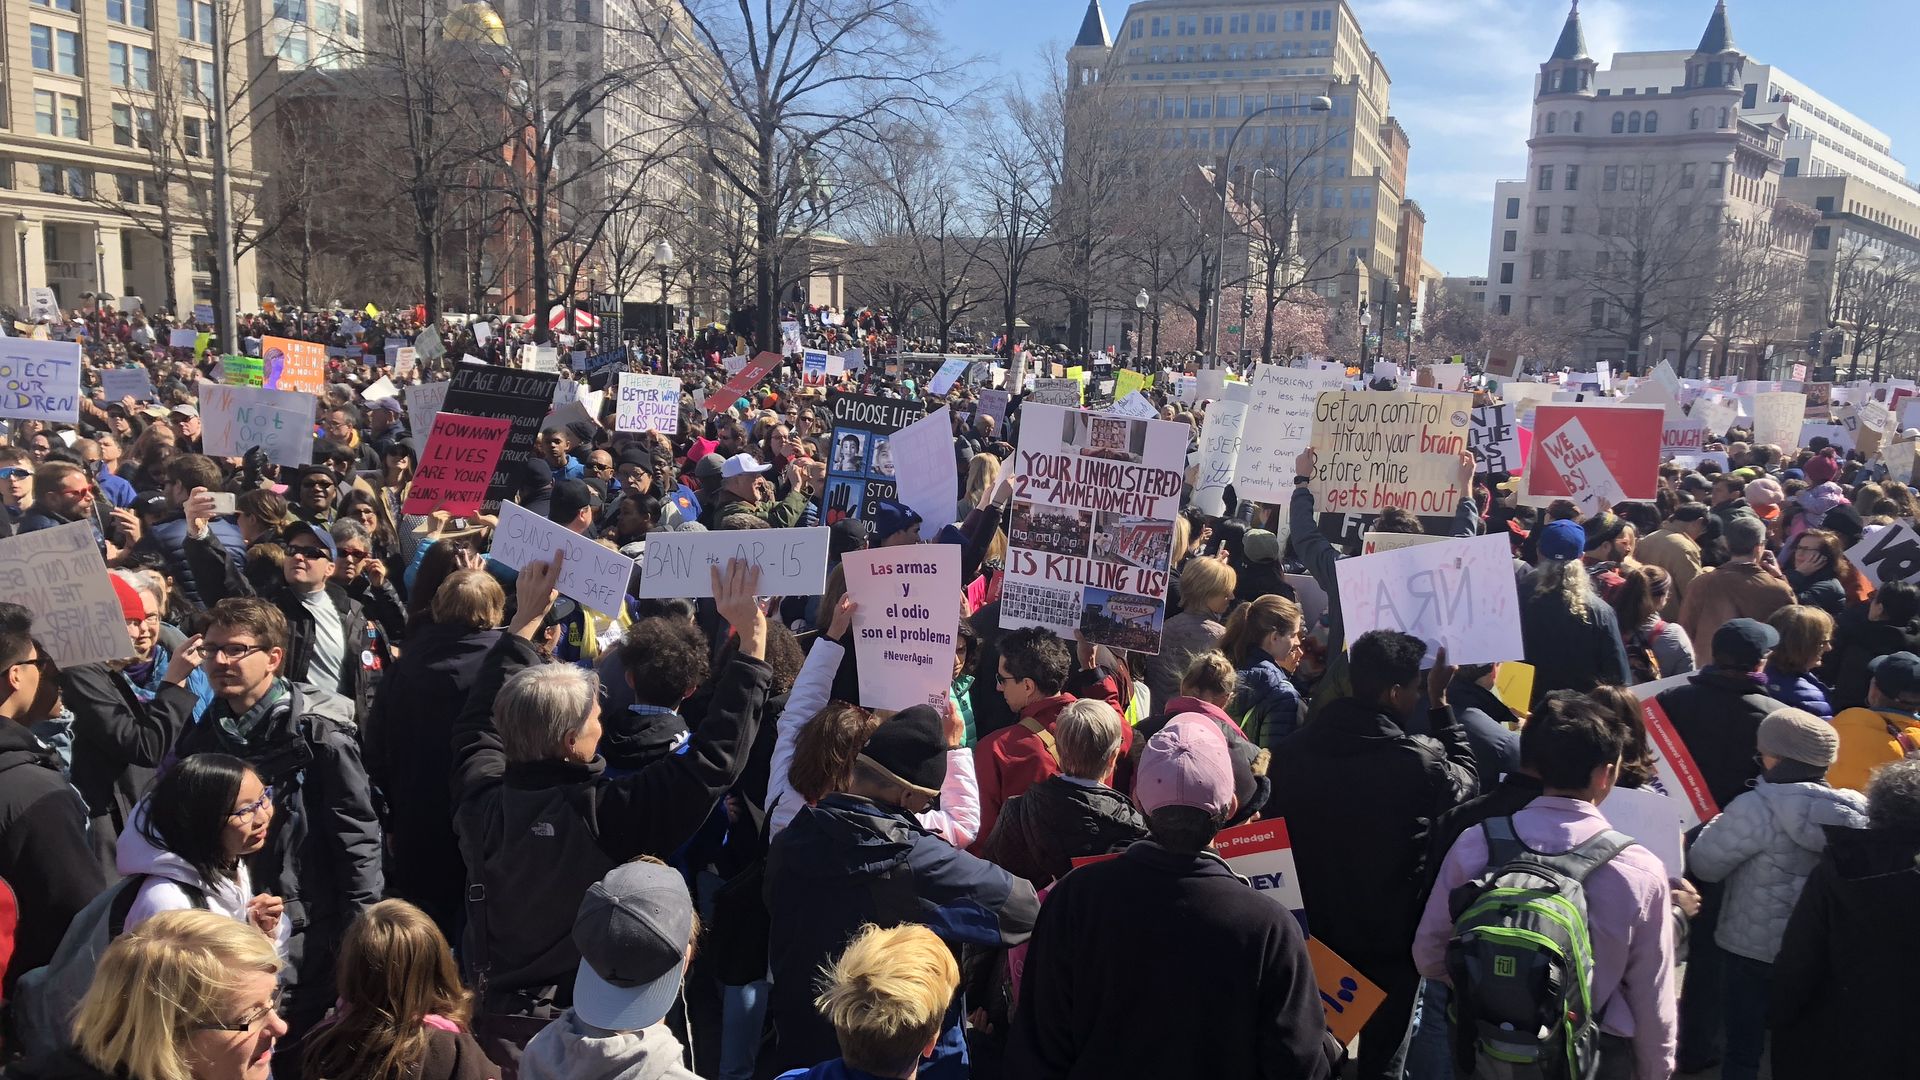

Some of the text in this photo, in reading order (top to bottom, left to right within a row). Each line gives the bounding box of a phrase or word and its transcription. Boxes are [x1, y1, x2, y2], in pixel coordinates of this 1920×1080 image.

[600, 295, 617, 312] M
[7, 380, 45, 393] OUR
[451, 369, 473, 388] AT
[469, 372, 498, 391] AGE
[498, 375, 511, 393] 18
[0, 392, 73, 413] LDREN
[622, 387, 659, 402] BETTER
[1278, 392, 1293, 401] less
[236, 407, 284, 429] Not
[636, 400, 677, 417] REDUCE
[835, 398, 889, 425] CHOOSE
[1252, 403, 1262, 412] of
[1268, 405, 1280, 415] the
[1316, 392, 1445, 432] Get gun control
[433, 420, 506, 441] HOW MANY
[618, 413, 677, 432] CLASS SIZE
[1282, 422, 1305, 437] YET
[240, 425, 279, 446] One
[511, 433, 534, 445] BEER
[1332, 423, 1463, 463] through your brain
[1543, 431, 1574, 459] WE
[236, 441, 280, 461] Me
[434, 444, 488, 464] LIVES
[1273, 448, 1295, 456] own
[1563, 444, 1596, 469] CALL
[416, 465, 487, 483] ARE YOUR
[1021, 450, 1182, 497] YOUR UNHOLSTERED
[1251, 461, 1261, 472] of
[1268, 463, 1282, 473] the
[1369, 459, 1409, 484] mine
[867, 482, 899, 499] STO
[1561, 468, 1591, 494] BS!
[408, 485, 482, 502] GUNS WORTH
[1015, 474, 1159, 517] 2nd AMMENDMENT
[1326, 483, 1457, 513] gets blown out
[507, 514, 627, 581] GUNS DO NOT
[644, 541, 805, 579] BAN the AR-15
[870, 563, 938, 576] Las armas
[1010, 550, 1168, 597] IS KILLING US!
[584, 578, 616, 605] SAFE
[902, 583, 910, 597] y
[886, 604, 930, 619] el odio
[1125, 606, 1149, 614] VEGAS
[862, 626, 951, 645] son el problema
[883, 650, 933, 666] #NeverAgain
[1678, 758, 1689, 776] Take
[1687, 774, 1696, 788] the
[1694, 786, 1711, 812] Pledge!
[1231, 831, 1275, 847] Pledge!
